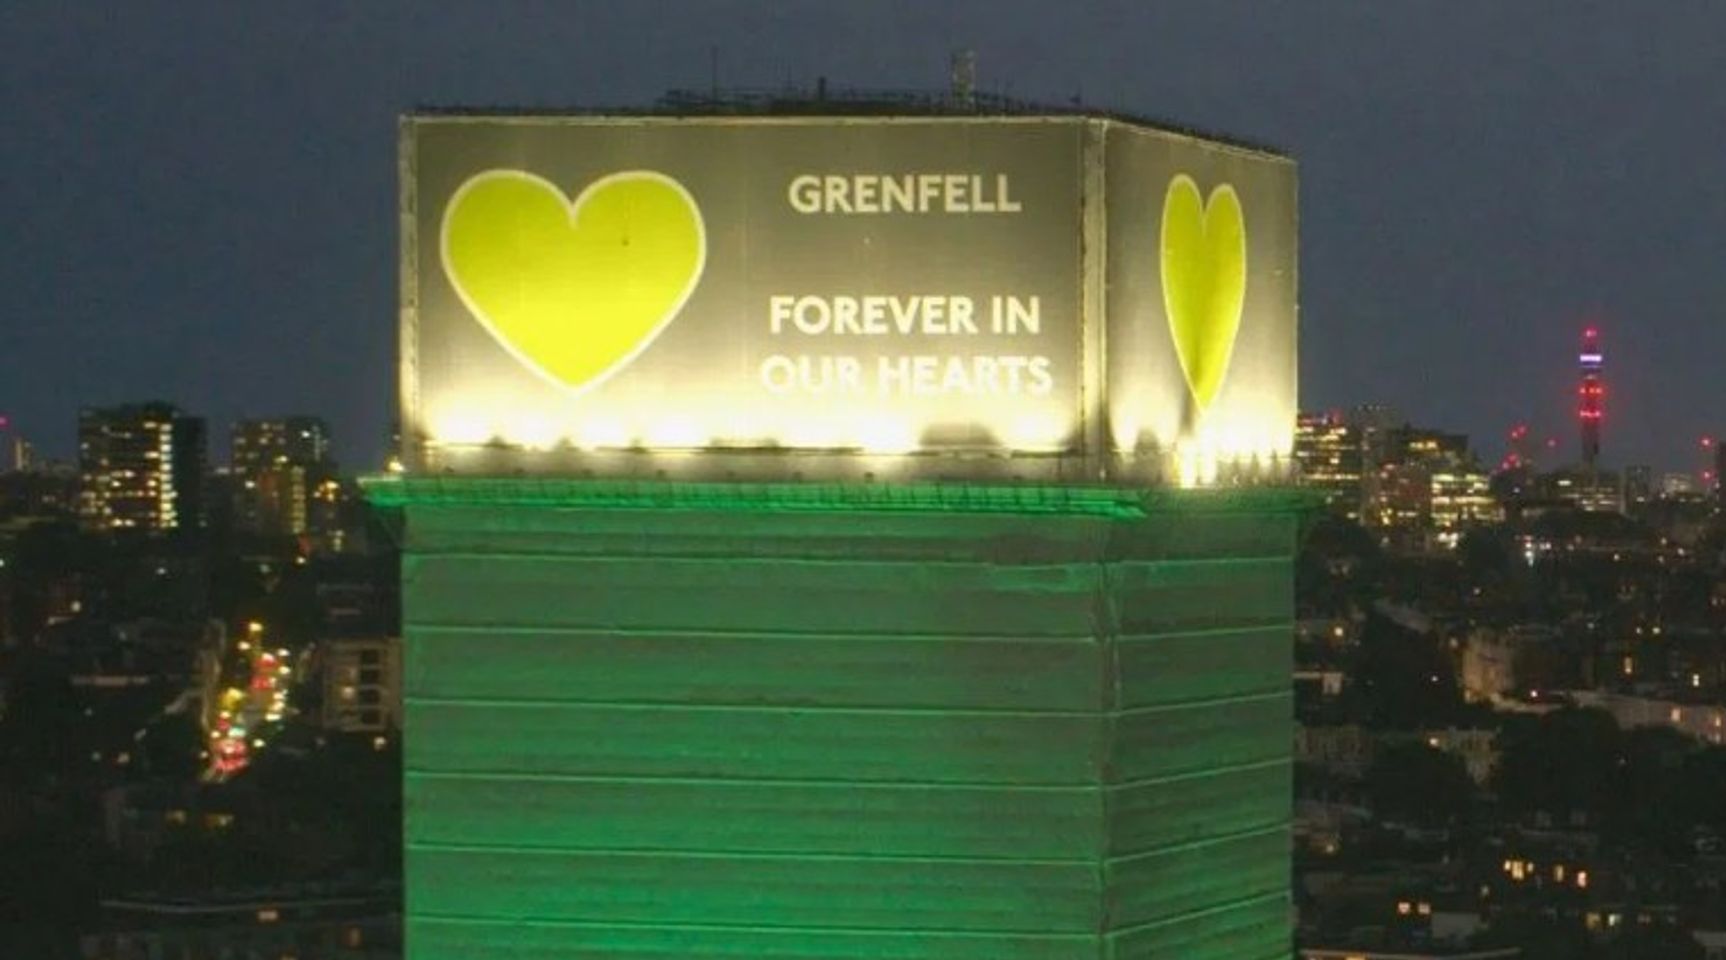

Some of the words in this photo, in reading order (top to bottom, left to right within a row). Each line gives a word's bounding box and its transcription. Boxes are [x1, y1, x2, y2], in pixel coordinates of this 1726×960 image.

[788, 174, 1022, 213] GRENFELL
[769, 295, 979, 335] FOREVER
[991, 295, 1041, 335] IN
[761, 354, 862, 396] OUR
[877, 354, 1054, 396] HEARTS
